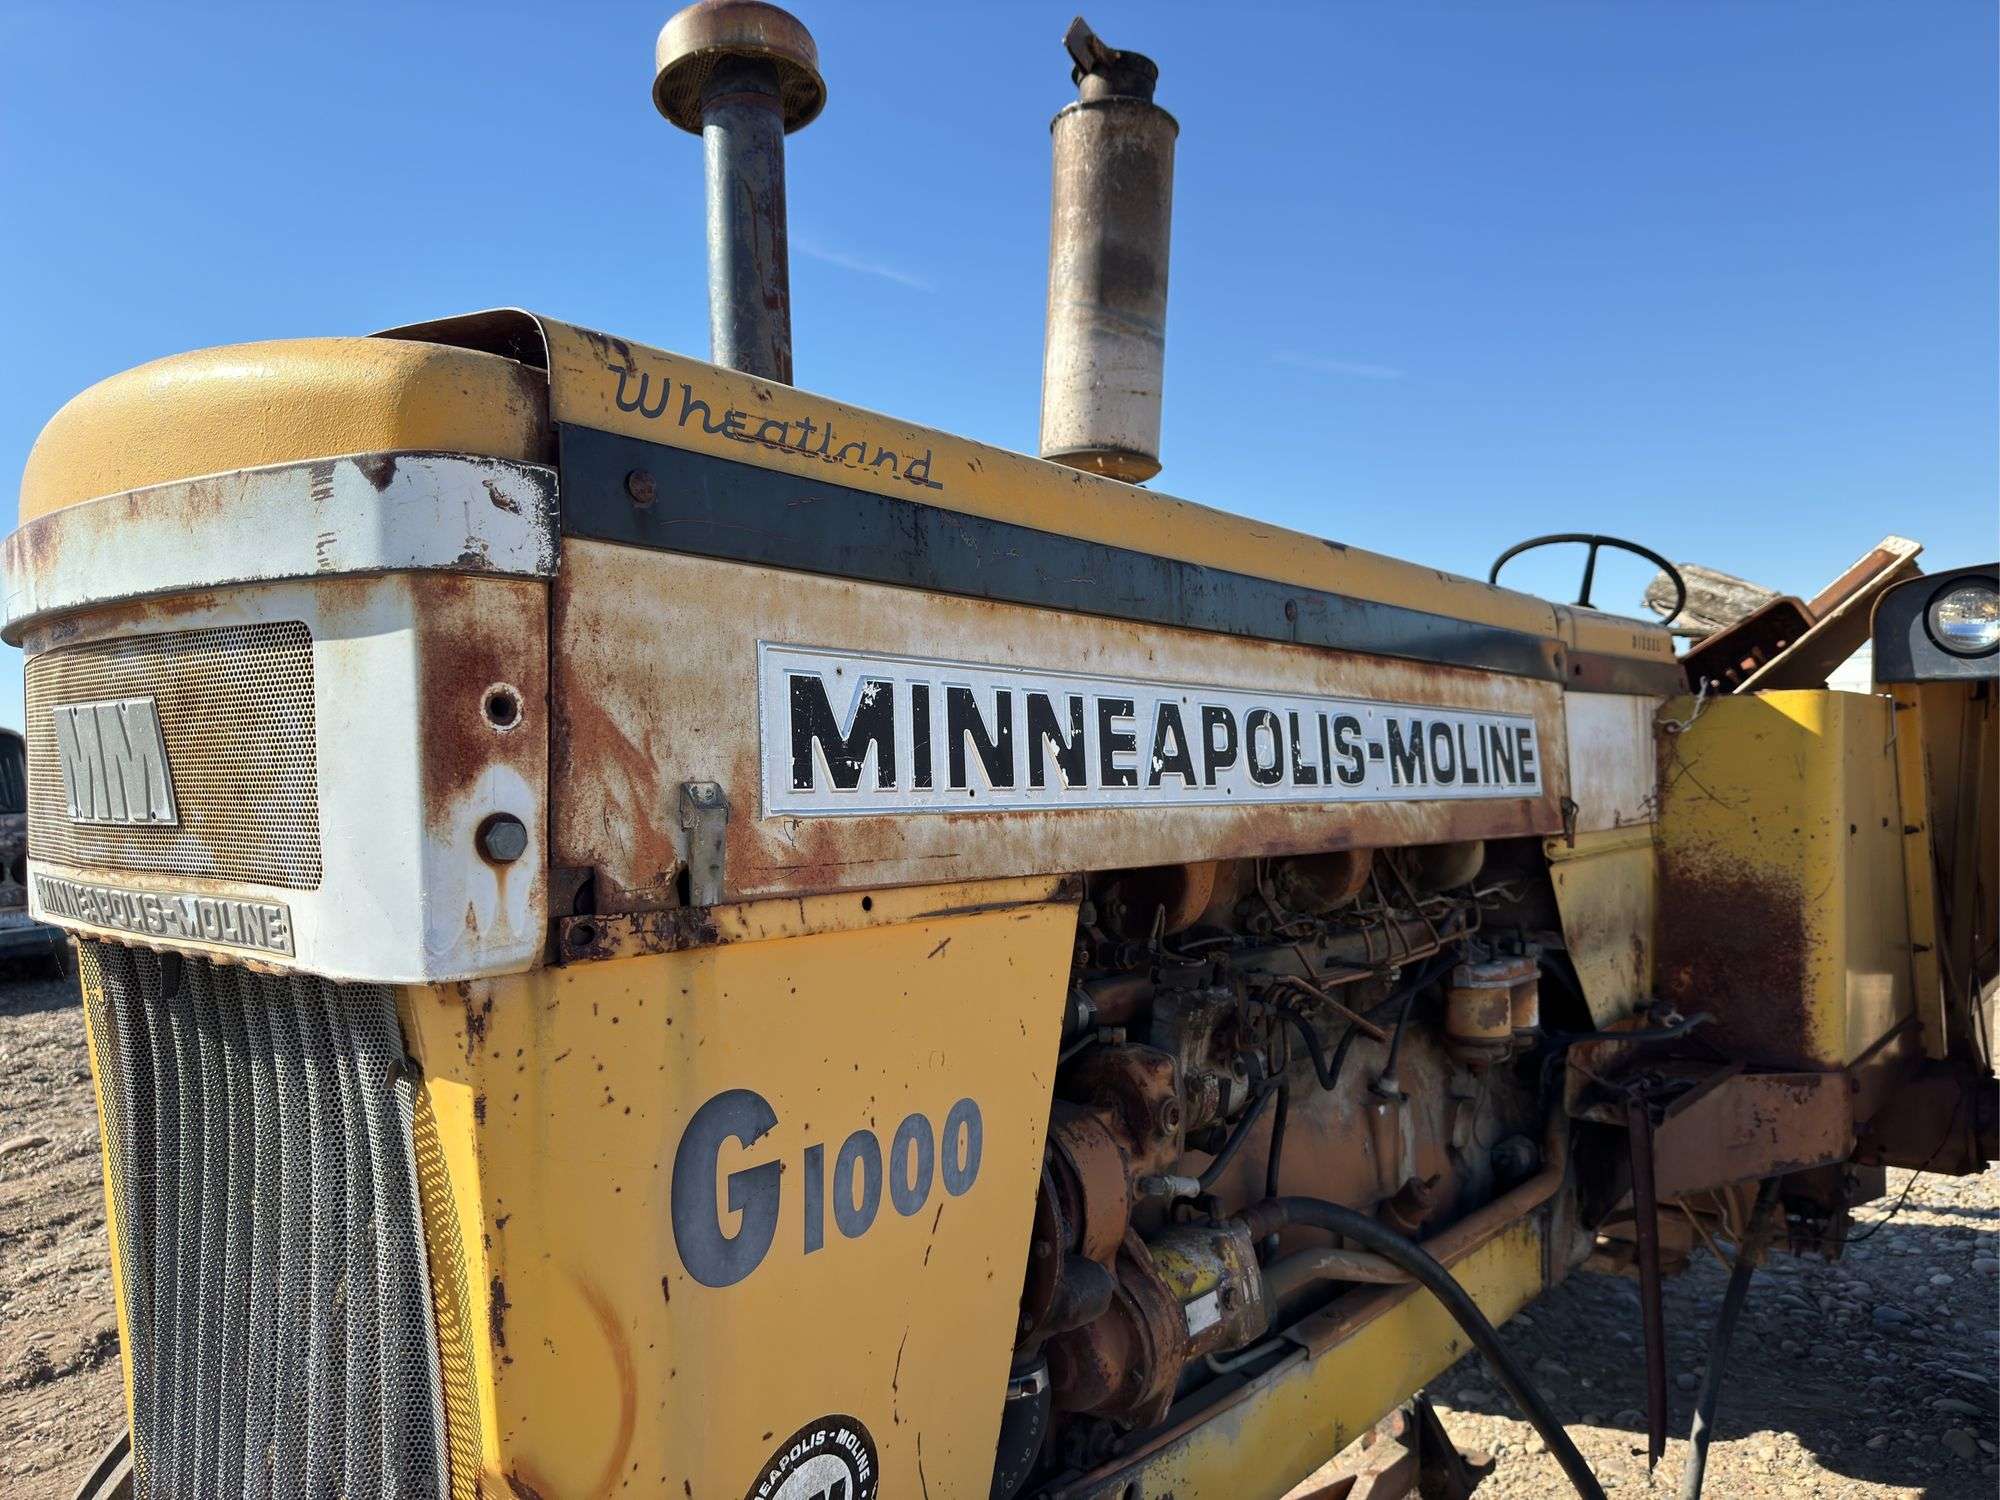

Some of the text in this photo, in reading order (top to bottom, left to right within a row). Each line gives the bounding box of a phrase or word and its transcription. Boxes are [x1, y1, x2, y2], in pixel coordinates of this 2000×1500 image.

[608, 364, 943, 490] Wheatland
[788, 674, 1537, 790] MINNEAPOLIS-MOLINE
[38, 877, 286, 951] MINNEAPOLIS-MOLINE
